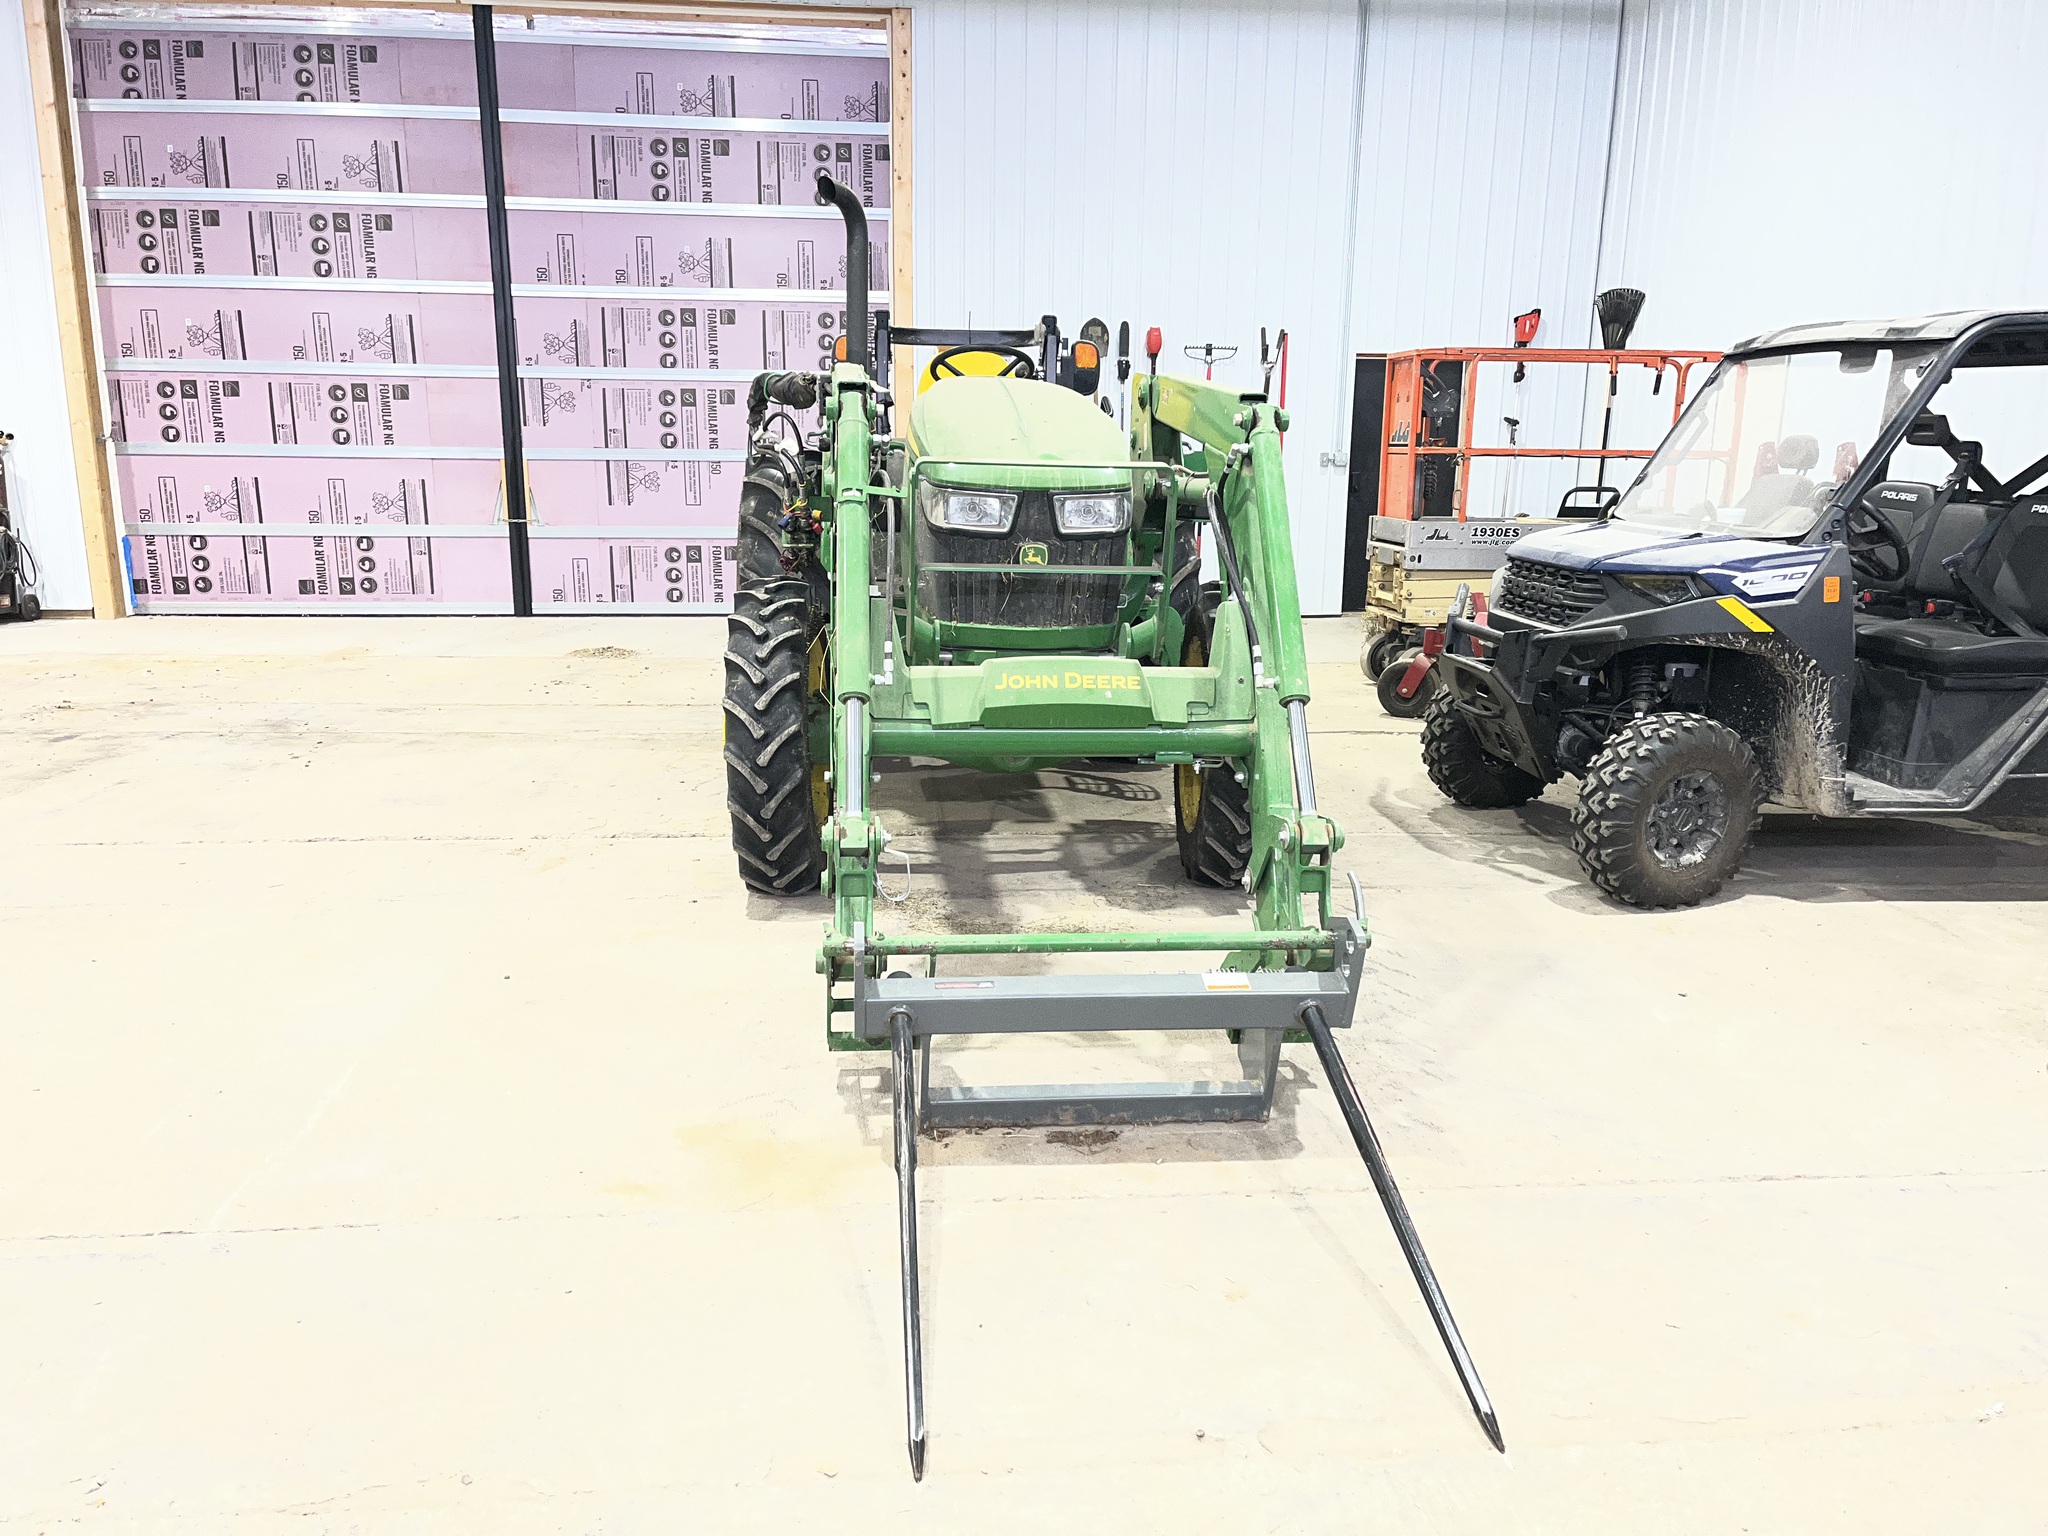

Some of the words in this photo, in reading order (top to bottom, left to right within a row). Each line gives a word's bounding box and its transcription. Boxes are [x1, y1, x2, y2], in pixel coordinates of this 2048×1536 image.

[172, 40, 186, 91] FOAMULAR
[346, 44, 360, 97] FOAMULAR
[700, 138, 712, 188] FOAMULAR
[863, 143, 873, 192] FOAMULAR
[104, 171, 115, 186] 150
[277, 174, 288, 189] 150
[702, 191, 712, 203] NG
[863, 195, 873, 208] NG
[189, 209, 204, 258] FOAMULAR
[362, 213, 376, 263] FOAMULAR
[194, 262, 205, 274] NG
[366, 266, 378, 278] NG
[537, 267, 547, 282] 150
[616, 269, 626, 284] 150
[777, 273, 787, 288] 150
[707, 309, 718, 356] FOAMULAR
[121, 343, 132, 358] 150
[293, 345, 304, 360] 150
[709, 359, 719, 369] NG
[208, 380, 223, 428] FOAMULAR
[379, 383, 393, 431] FOAMULAR
[707, 389, 718, 436] FOAMULAR
[214, 431, 225, 443] NG
[384, 433, 394, 445] NG
[709, 439, 719, 449] NG
[710, 461, 721, 474] 150
[1880, 490, 1918, 502] POLARIS
[140, 508, 150, 523] 150
[309, 510, 320, 524] 150
[1471, 527, 1520, 538] 1930ES
[145, 536, 156, 546] NG
[313, 536, 323, 547] NG
[148, 550, 162, 594] FOAMULAR
[314, 550, 328, 594] FOAMULAR
[712, 546, 723, 590] FOAMULAR
[553, 589, 563, 602] 150
[714, 592, 723, 603] NG
[994, 672, 1058, 690] JOHN
[1064, 672, 1142, 690] DEERE
